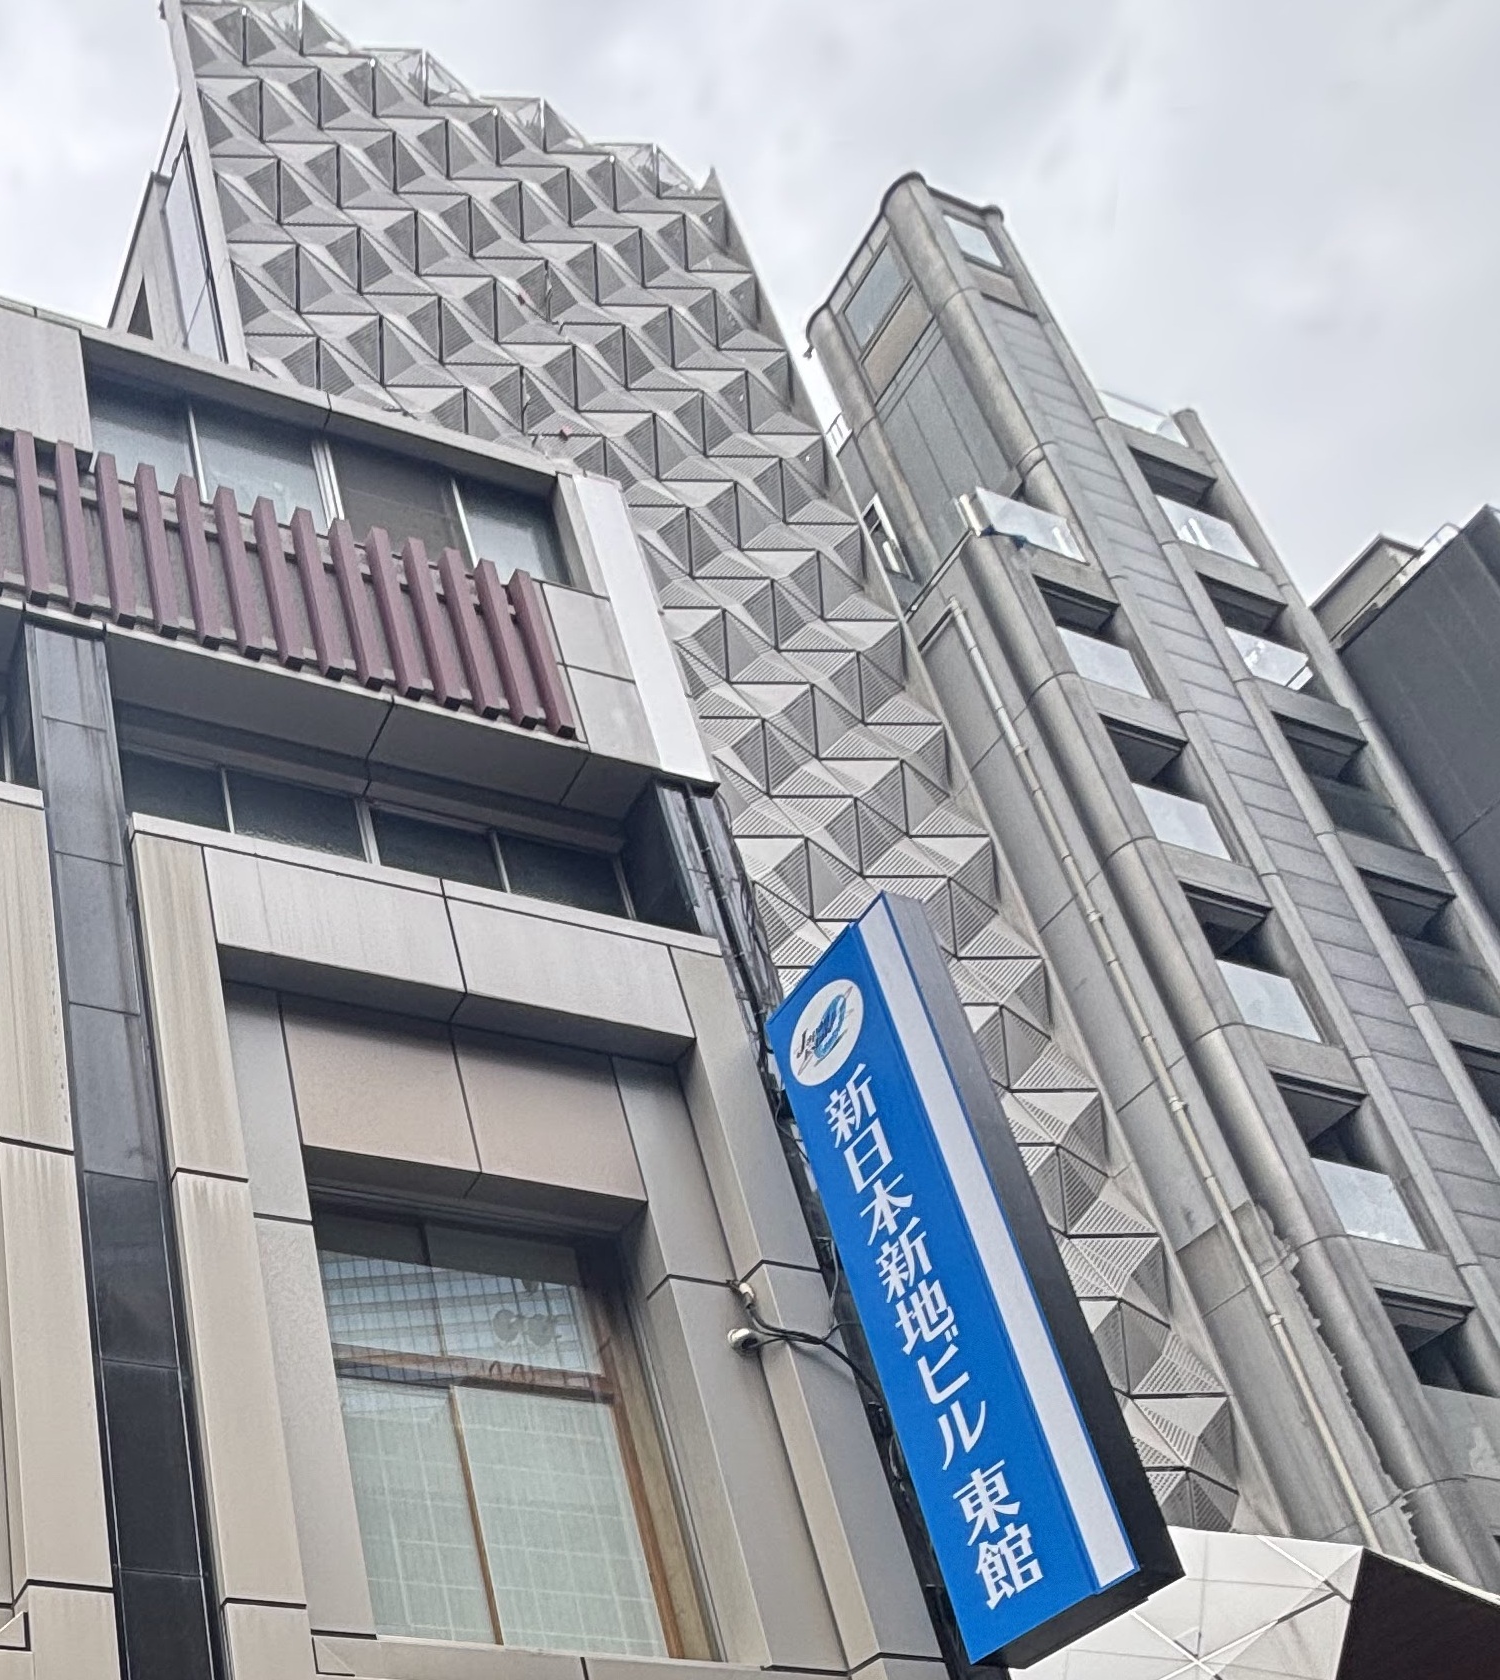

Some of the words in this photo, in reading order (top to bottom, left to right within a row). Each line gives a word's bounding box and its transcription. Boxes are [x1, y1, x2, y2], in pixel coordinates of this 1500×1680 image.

[825, 1063, 987, 1472] 新日本新地ビル
[953, 1459, 1044, 1609] 東館
